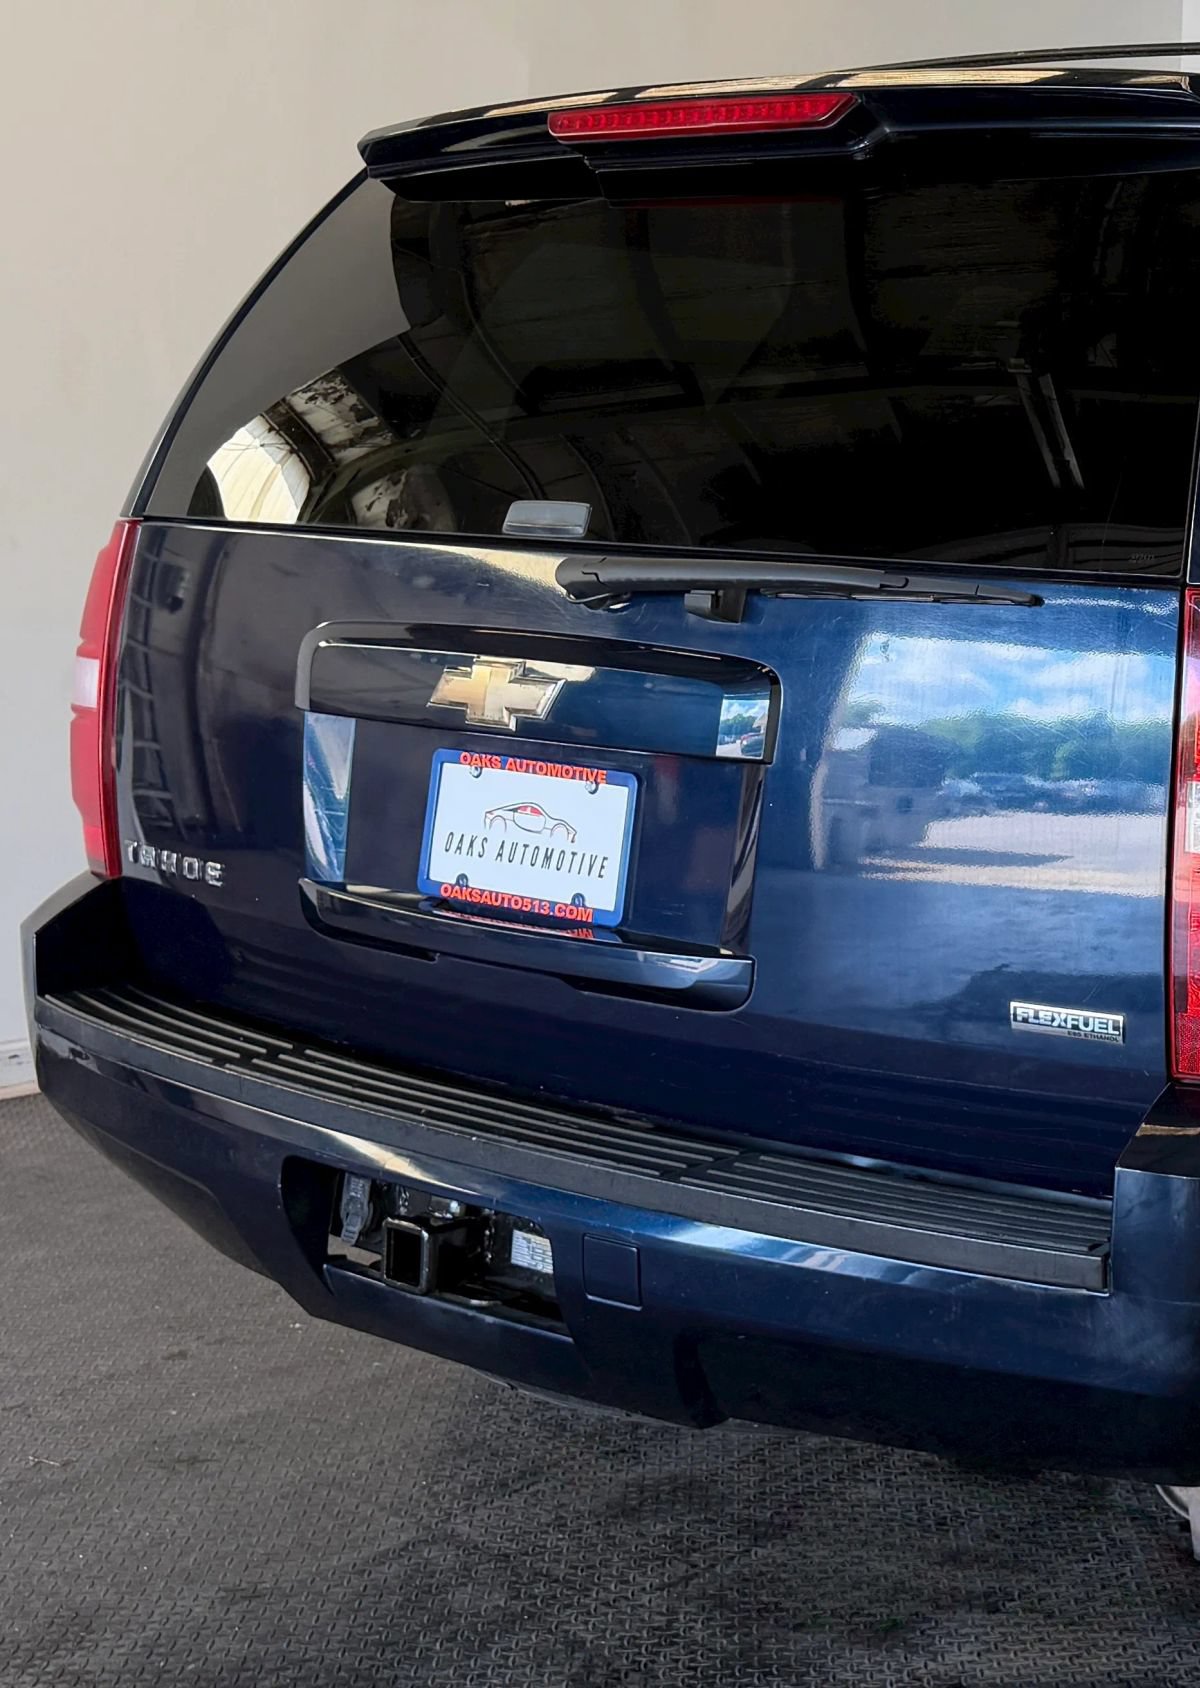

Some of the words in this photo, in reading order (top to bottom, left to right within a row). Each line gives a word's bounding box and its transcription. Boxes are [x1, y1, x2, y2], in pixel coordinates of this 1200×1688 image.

[460, 752, 501, 769] OAKS
[505, 759, 607, 783] AUTOMOTIVE
[445, 832, 488, 858] OAKS
[496, 840, 608, 878] AUTOMOTIVE
[440, 884, 594, 921] OAKSAUTO513.COM
[1016, 1007, 1119, 1034] FLEXFUEL
